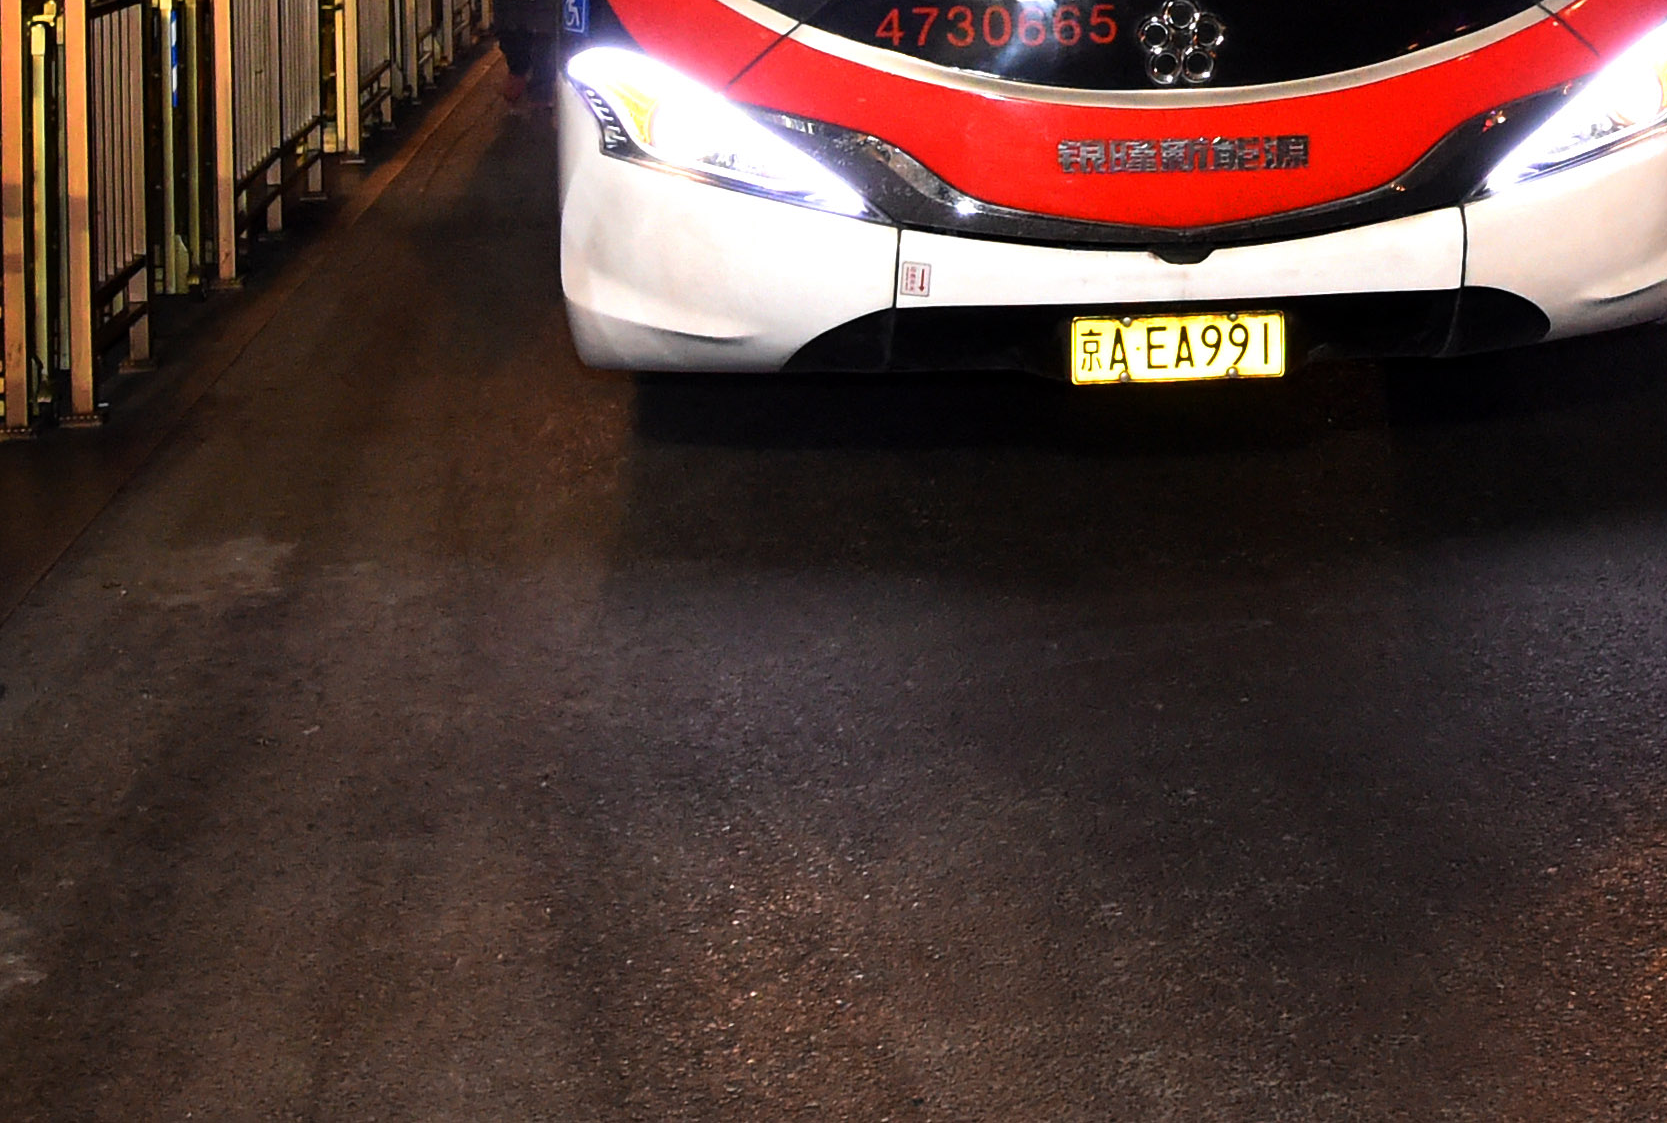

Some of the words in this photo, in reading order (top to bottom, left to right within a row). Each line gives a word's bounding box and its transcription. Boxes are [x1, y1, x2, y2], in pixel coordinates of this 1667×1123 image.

[875, 3, 1117, 47] 4730665
[1057, 134, 1309, 174] 银隆新能源
